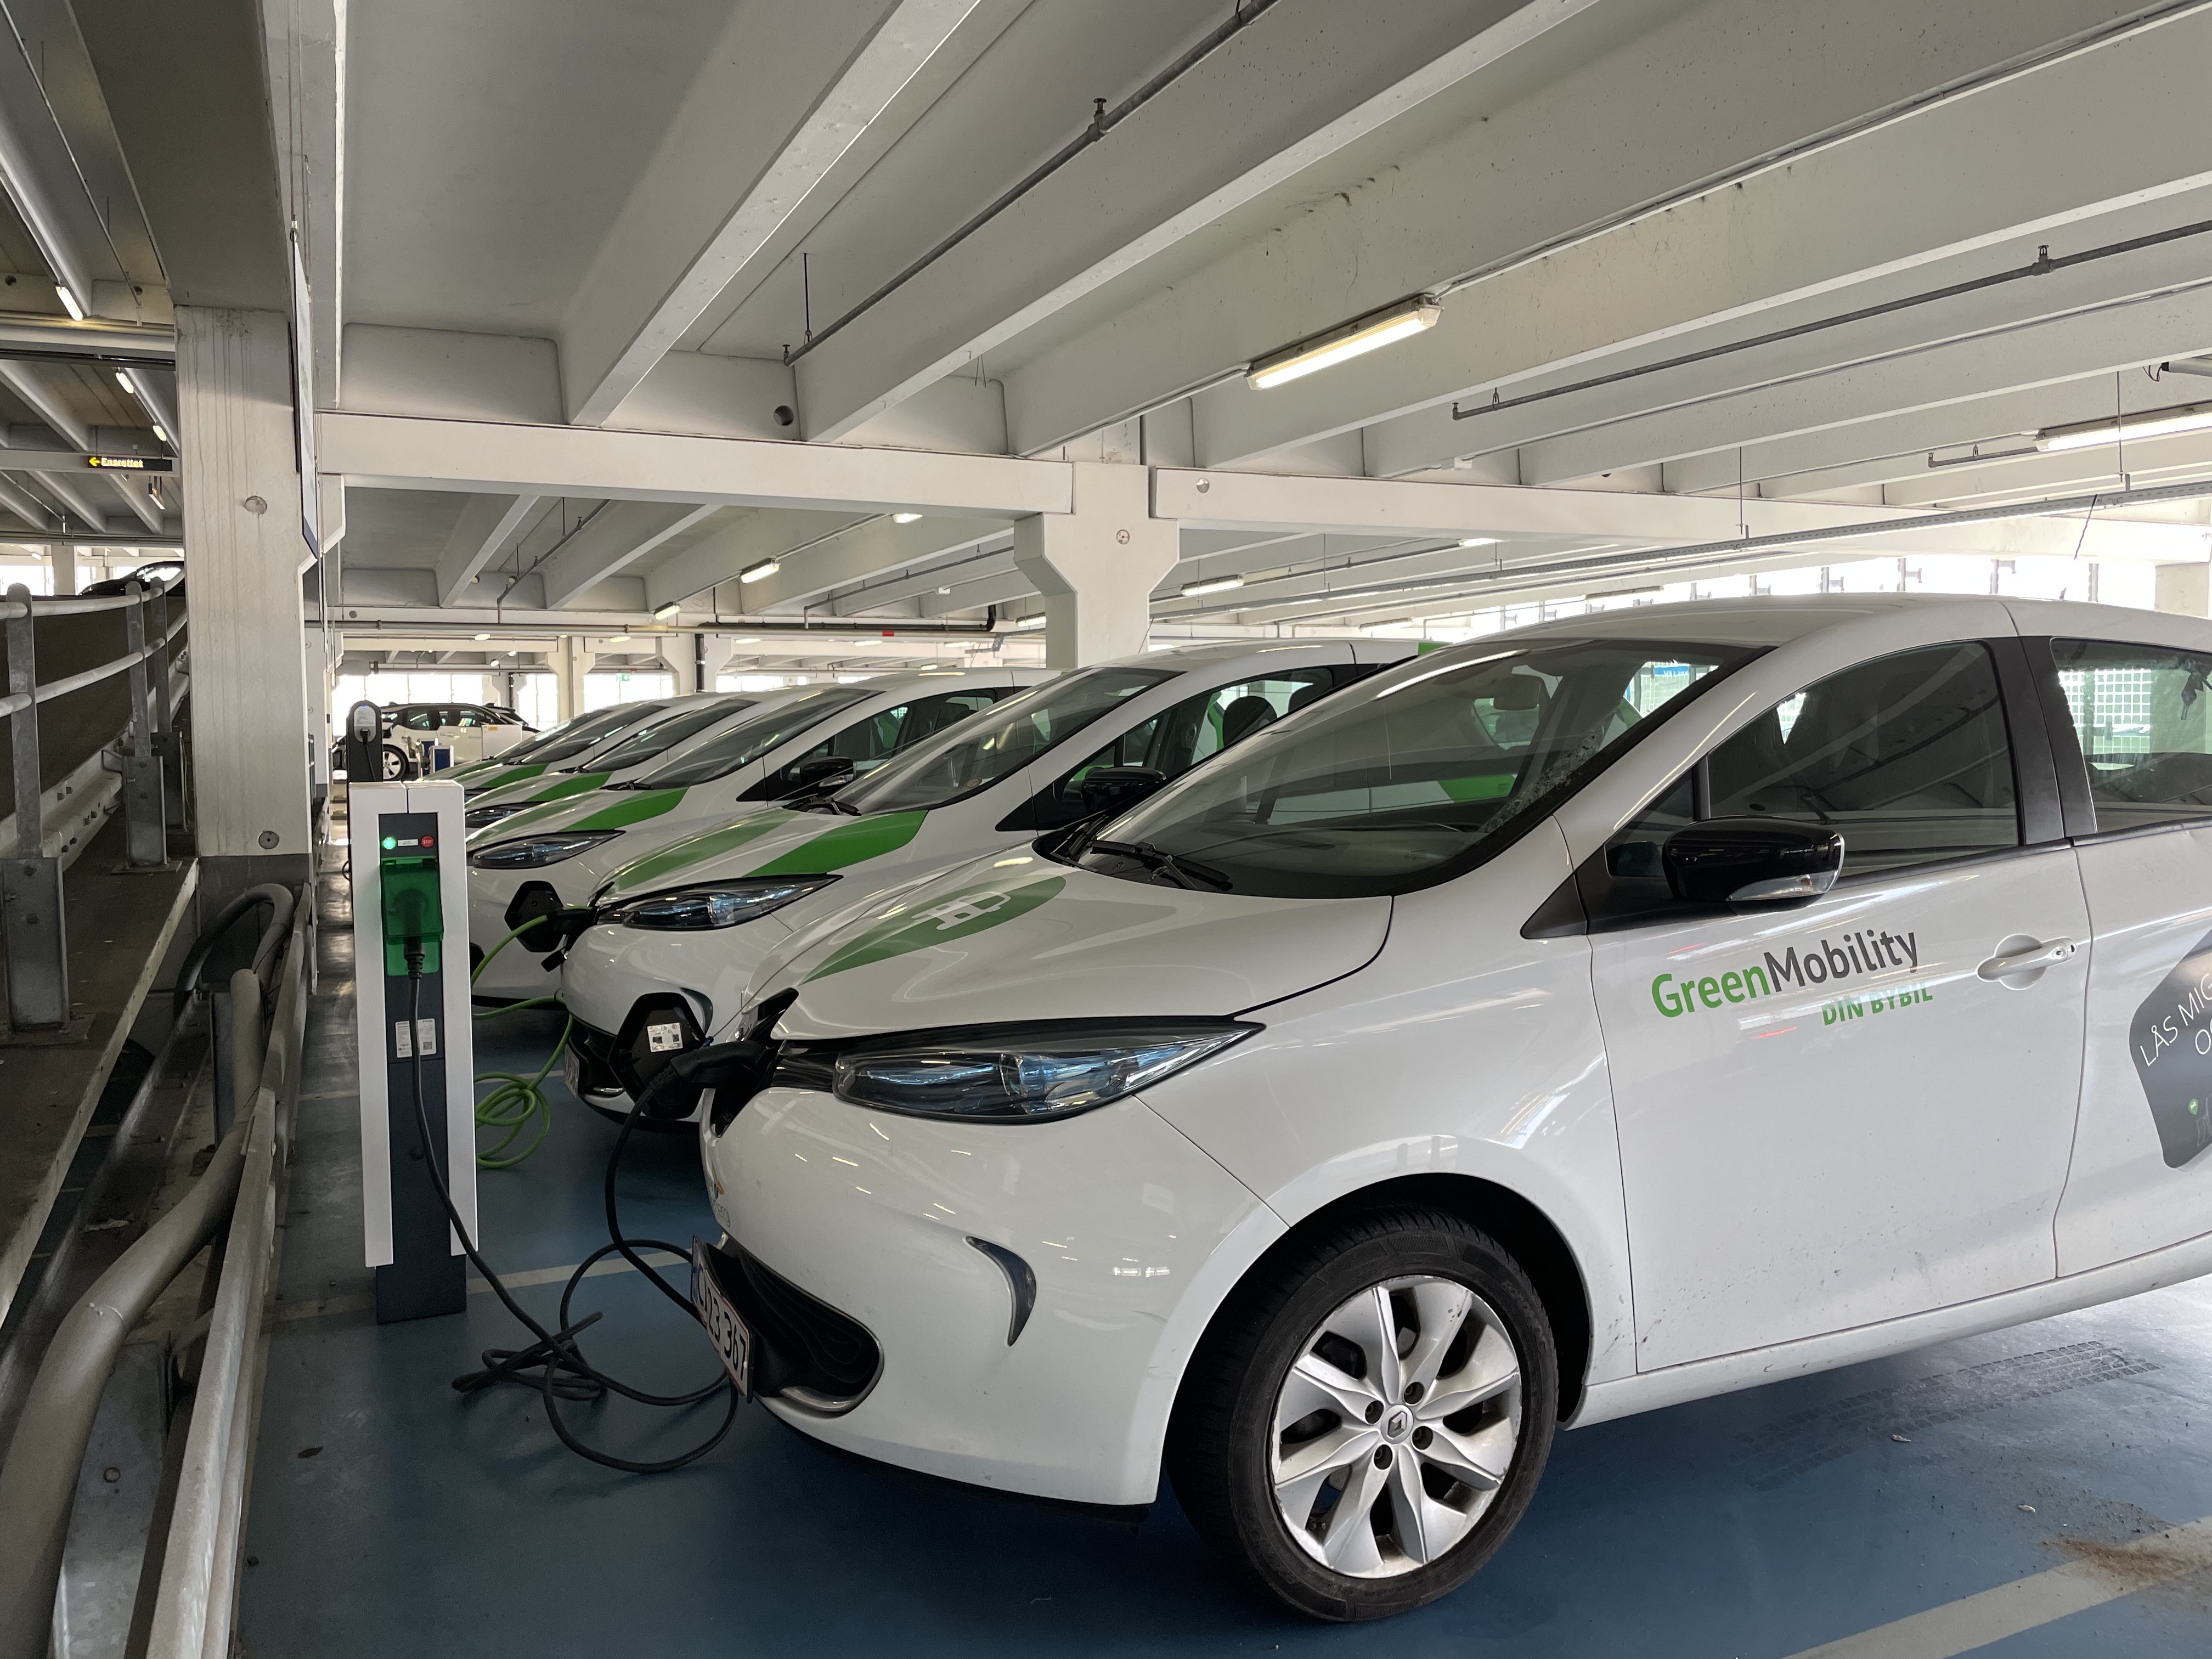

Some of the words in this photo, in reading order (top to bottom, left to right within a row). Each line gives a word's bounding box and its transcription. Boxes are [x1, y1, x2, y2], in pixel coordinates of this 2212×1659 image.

[101, 458, 144, 468] Ensrettet
[1651, 929, 1918, 1018] GreenMobility
[1822, 997, 1864, 1026] DIN
[1871, 982, 1933, 1014] BYBIL
[2140, 1015, 2178, 1067] LÅS
[2195, 1017, 2212, 1055] O
[724, 1311, 746, 1382] 367
